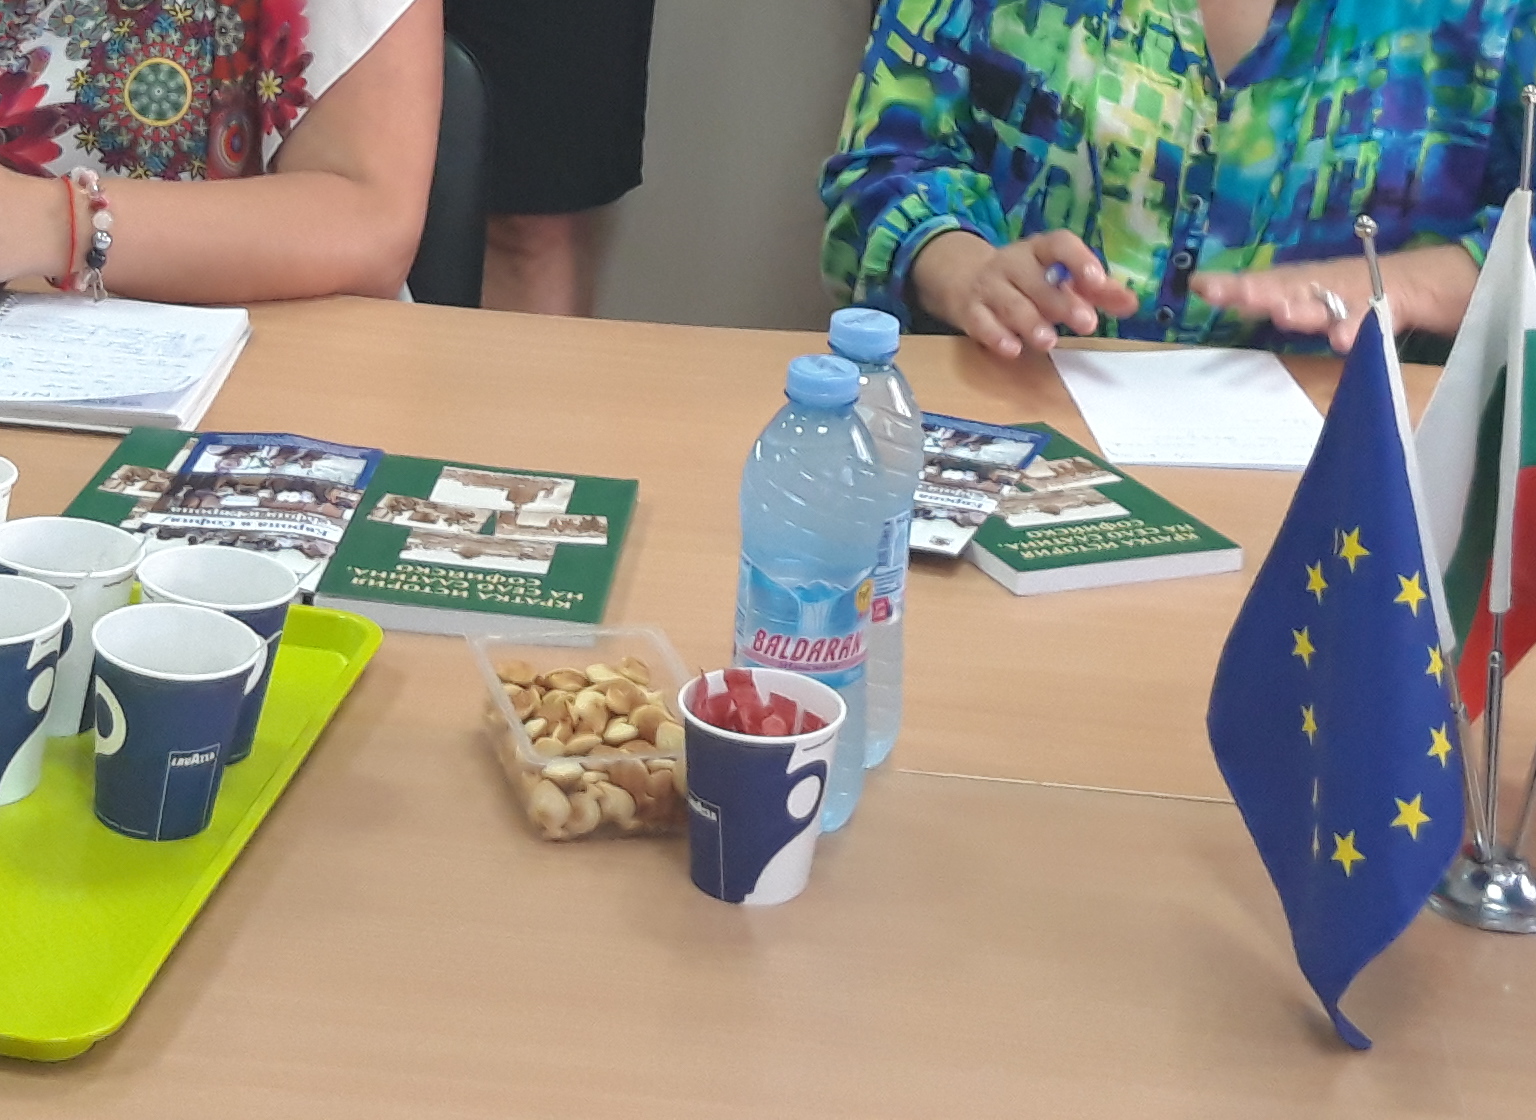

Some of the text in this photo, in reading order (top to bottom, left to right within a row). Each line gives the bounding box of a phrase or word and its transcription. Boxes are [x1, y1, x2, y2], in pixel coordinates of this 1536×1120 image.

[1020, 532, 1200, 560] КРАТКА ИСТОРИЯ
[350, 576, 572, 609] КРАТКА ИСТОРИЯ
[477, 582, 542, 597] СЕЛО
[550, 589, 584, 601] НА
[753, 629, 861, 662] BALDARAN
